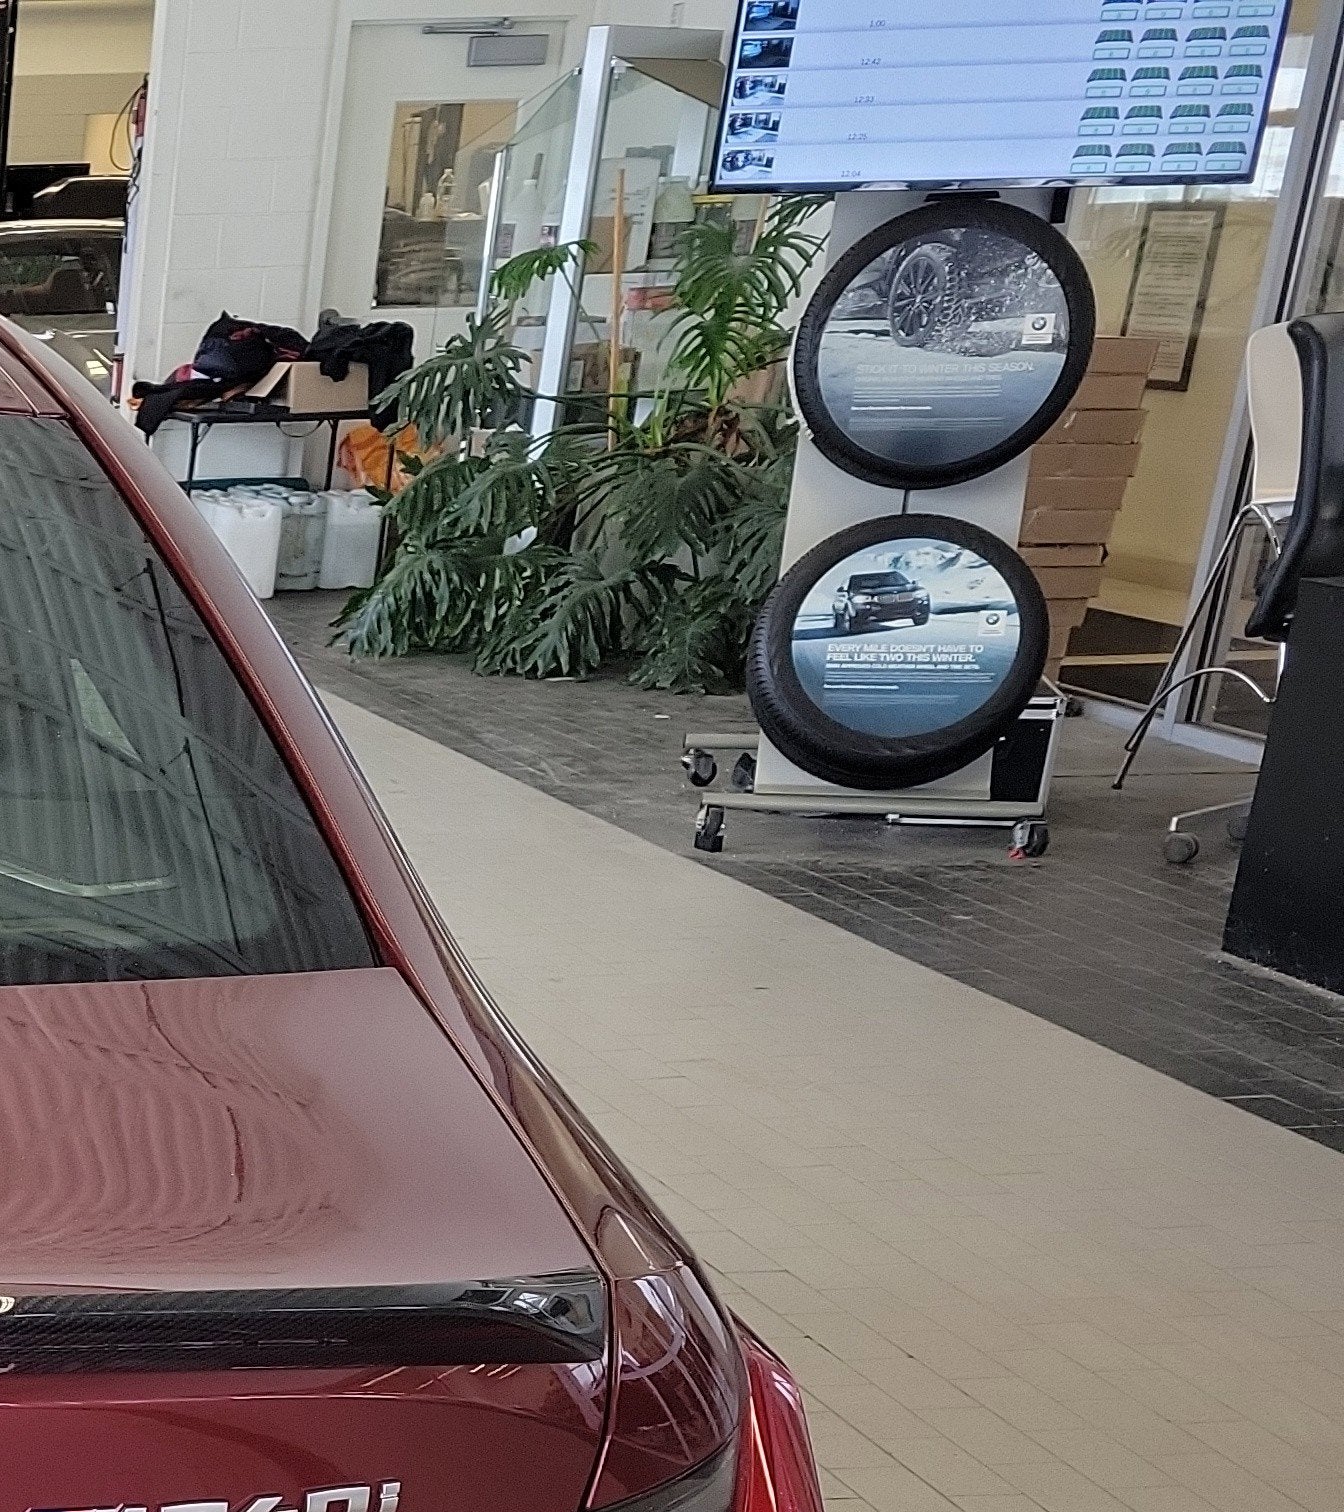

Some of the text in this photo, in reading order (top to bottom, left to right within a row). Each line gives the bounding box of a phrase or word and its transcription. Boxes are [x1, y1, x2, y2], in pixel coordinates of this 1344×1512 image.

[962, 363, 986, 373] THIS
[827, 644, 862, 653] EVERY
[863, 644, 889, 653] MILE
[938, 645, 967, 654] HAVE
[969, 645, 984, 654] TO
[826, 653, 853, 662] FEEL
[854, 653, 878, 662] LIKE
[880, 653, 904, 662] TWO
[906, 653, 930, 662] THIS
